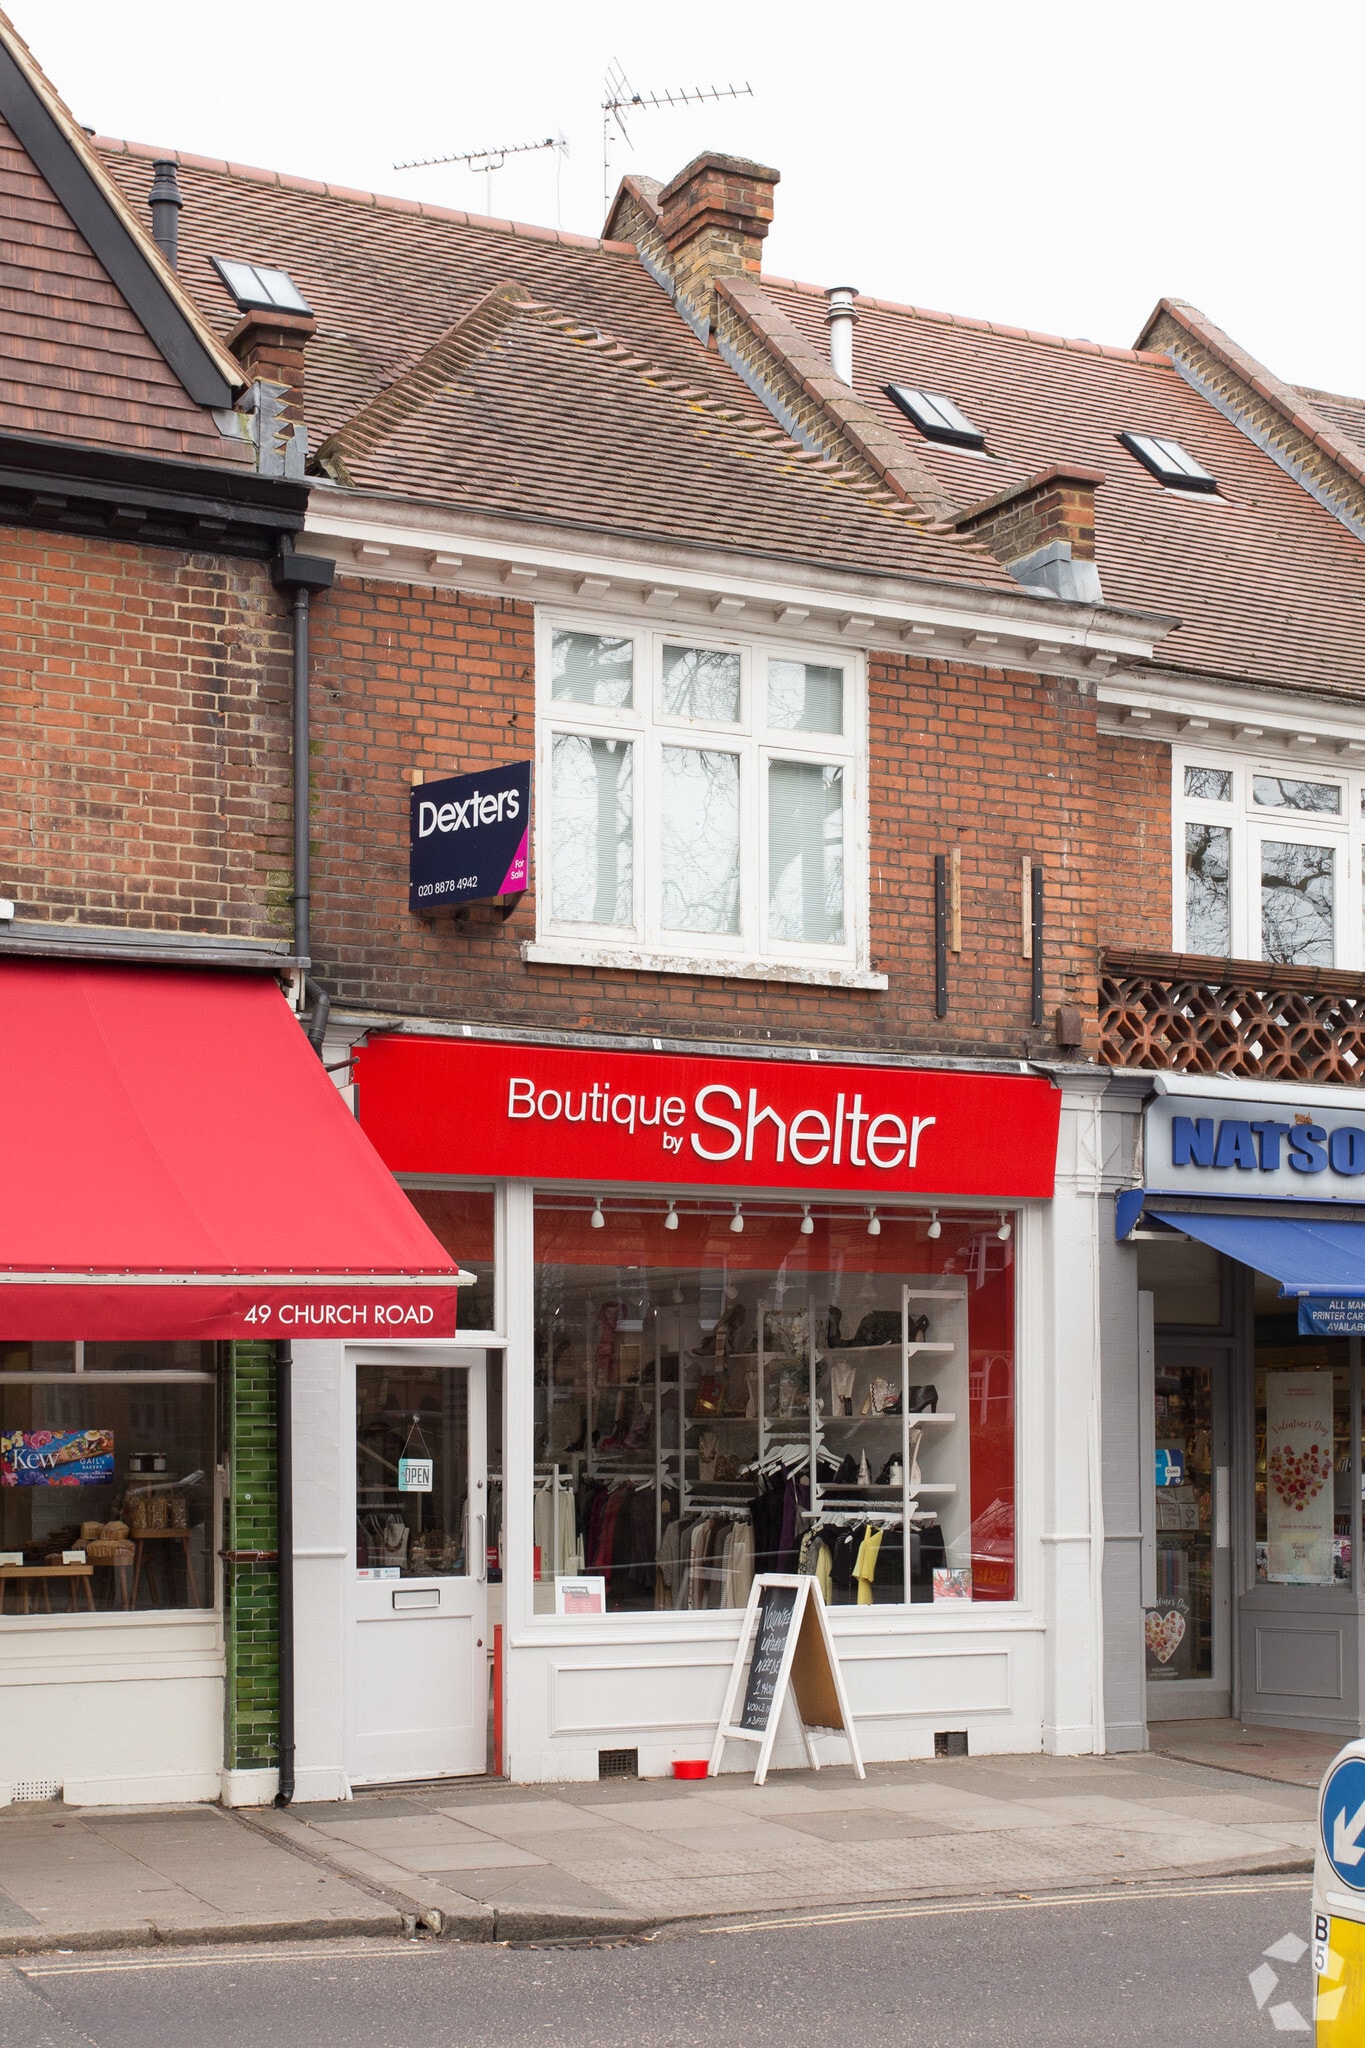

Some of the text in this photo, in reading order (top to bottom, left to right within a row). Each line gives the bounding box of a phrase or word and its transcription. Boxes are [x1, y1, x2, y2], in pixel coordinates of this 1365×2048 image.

[419, 788, 520, 838] Dexters
[515, 859, 524, 868] For
[510, 870, 524, 880] Sale
[418, 875, 478, 897] 020 8878 4942
[507, 1077, 686, 1134] Boutique
[691, 1084, 936, 1168] Shelter
[662, 1131, 683, 1155] by
[244, 1304, 434, 1325] 49 CHURCH ROAD
[1312, 1311, 1345, 1320] PRINTER
[1328, 1301, 1346, 1310] ALL
[13, 1448, 62, 1469] Kew
[405, 1467, 430, 1484] OPEN
[563, 1586, 587, 1594] Opening
[1315, 1915, 1328, 1943] B
[1314, 1946, 1325, 1971] 5
